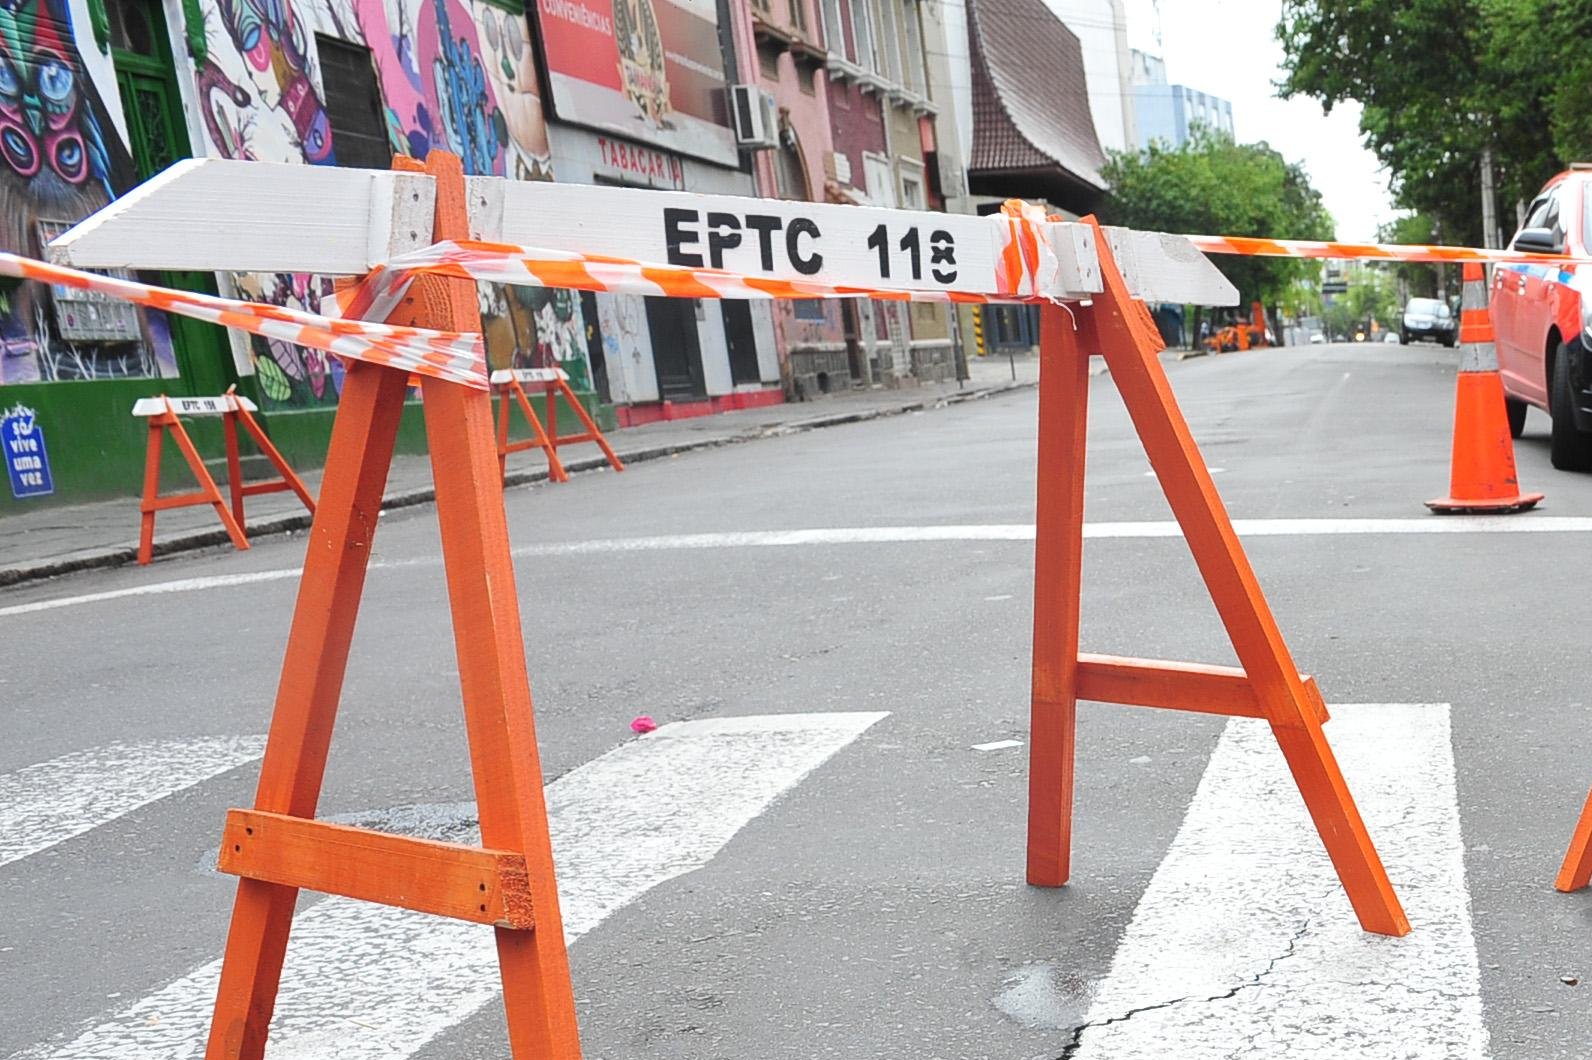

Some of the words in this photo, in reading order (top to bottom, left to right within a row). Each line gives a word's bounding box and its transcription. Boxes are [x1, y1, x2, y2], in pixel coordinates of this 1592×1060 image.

[598, 138, 682, 182] TABACARIA
[663, 207, 824, 275] EPTC
[867, 223, 958, 284] 118
[10, 434, 38, 453] vive
[13, 456, 42, 471] uma
[20, 472, 43, 486] vez
